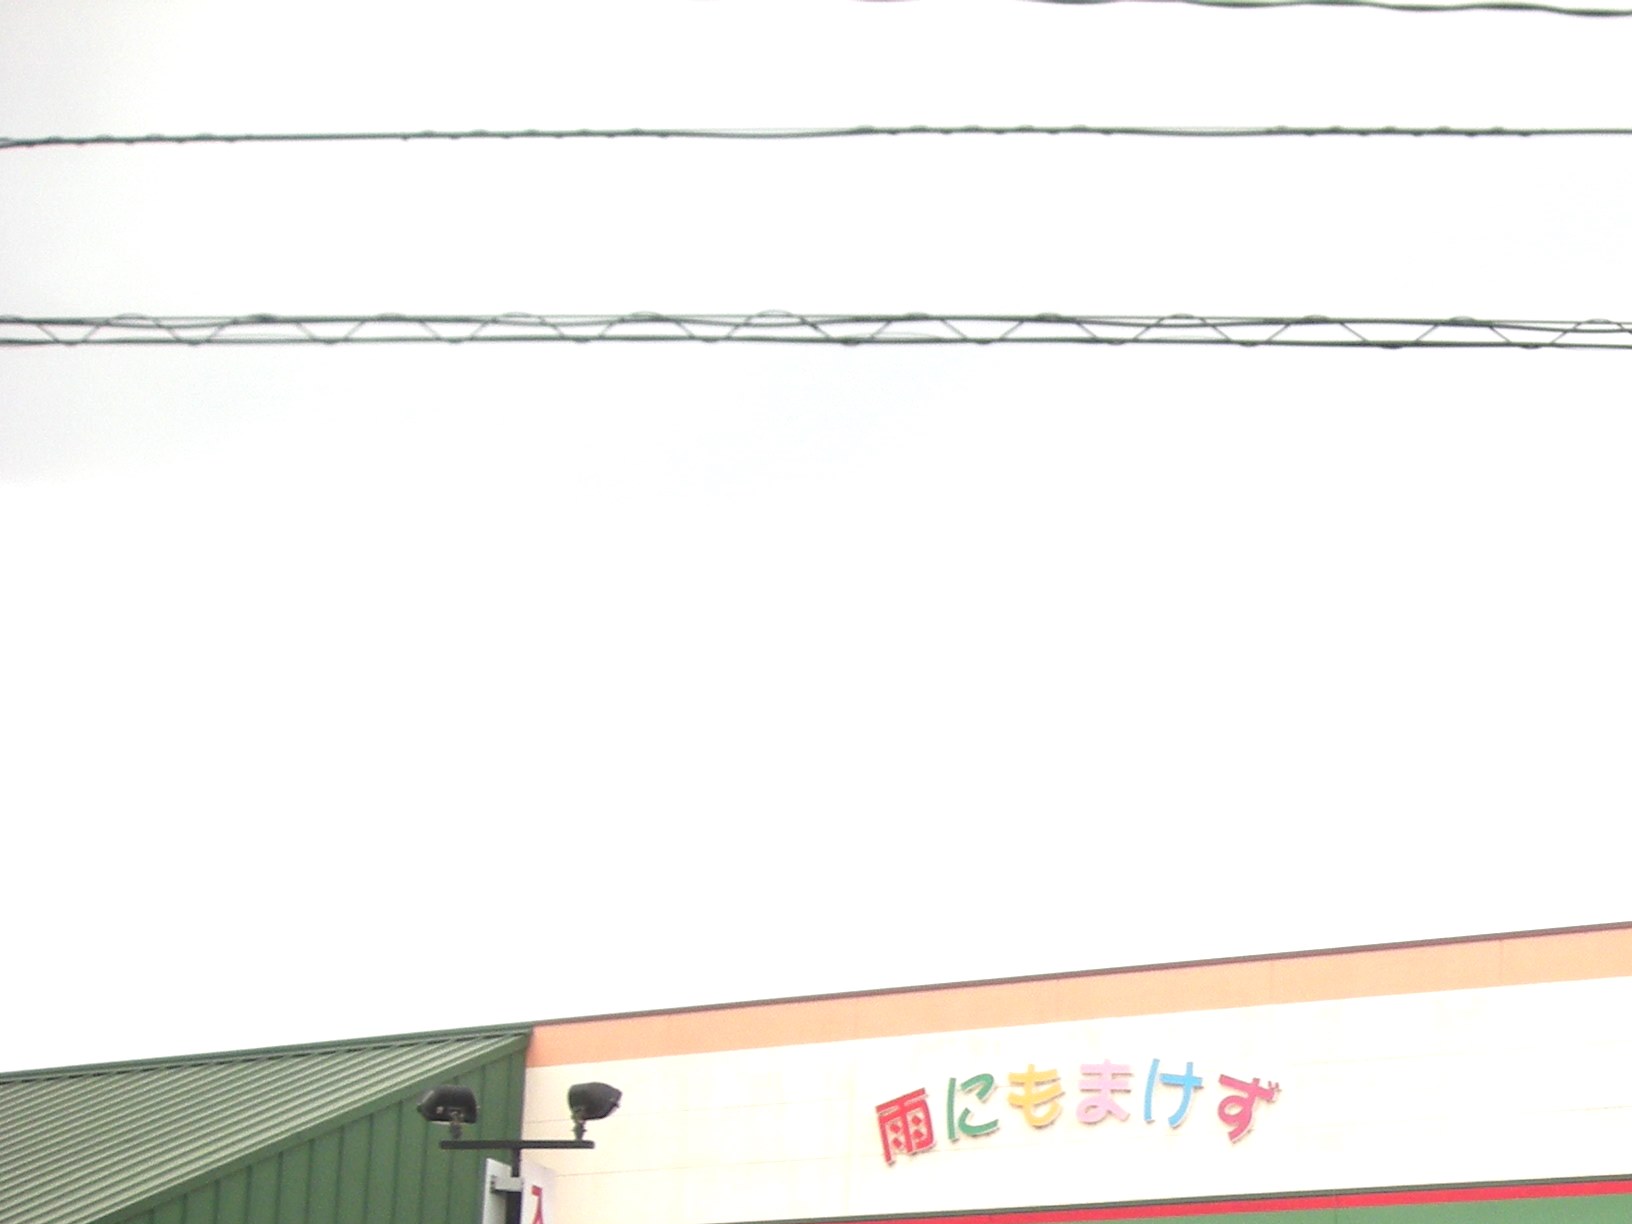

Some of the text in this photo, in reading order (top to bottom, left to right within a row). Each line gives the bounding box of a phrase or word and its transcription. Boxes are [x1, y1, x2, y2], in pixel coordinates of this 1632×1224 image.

[875, 1058, 1281, 1167] 雨にもまけず
